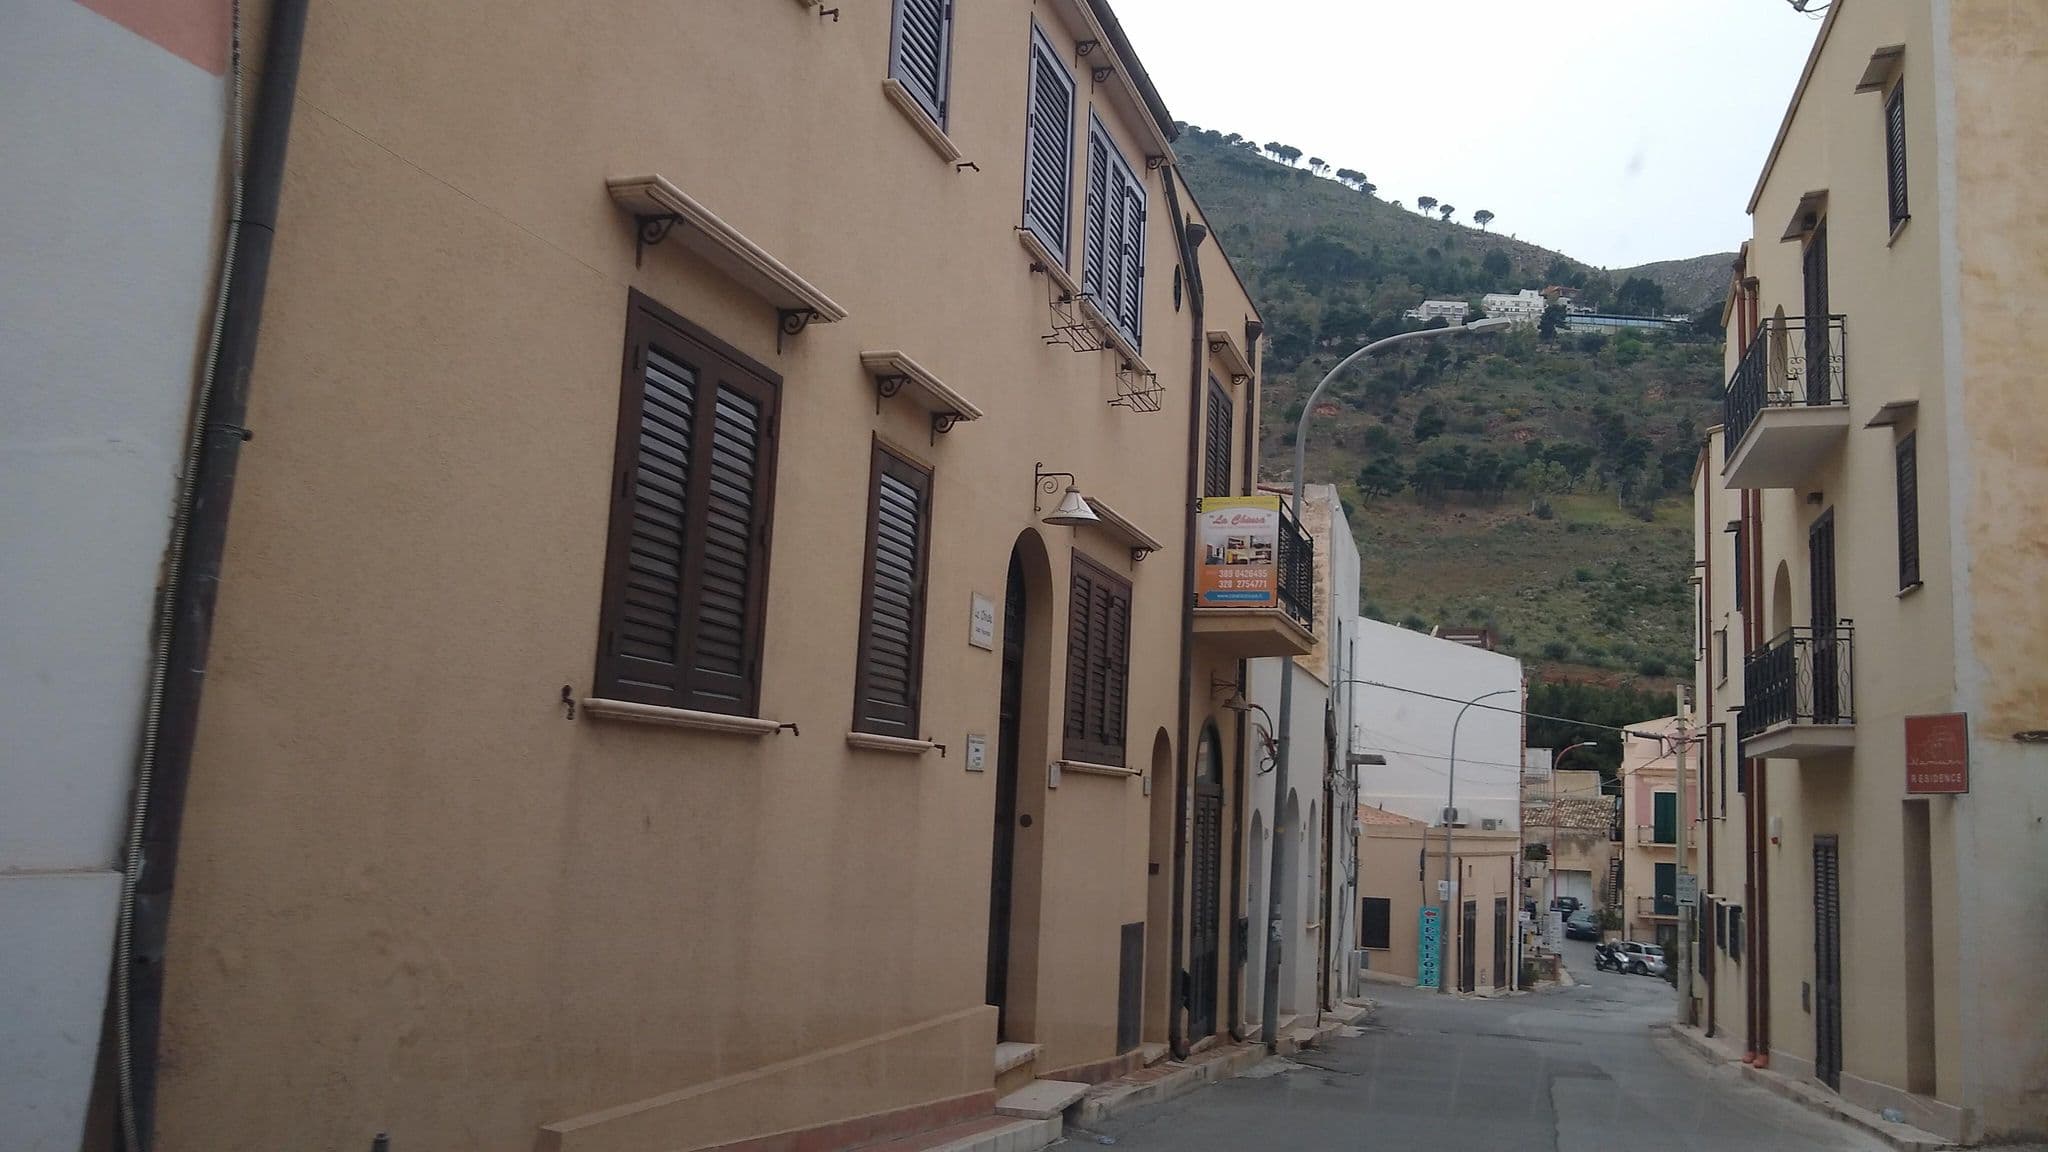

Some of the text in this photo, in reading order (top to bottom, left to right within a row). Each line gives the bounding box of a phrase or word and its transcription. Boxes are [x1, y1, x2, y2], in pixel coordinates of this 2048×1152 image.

[1236, 579, 1267, 588] 2754771
[1911, 772, 1962, 784] RESIDENCE
[1424, 918, 1435, 985] PENELOPE
